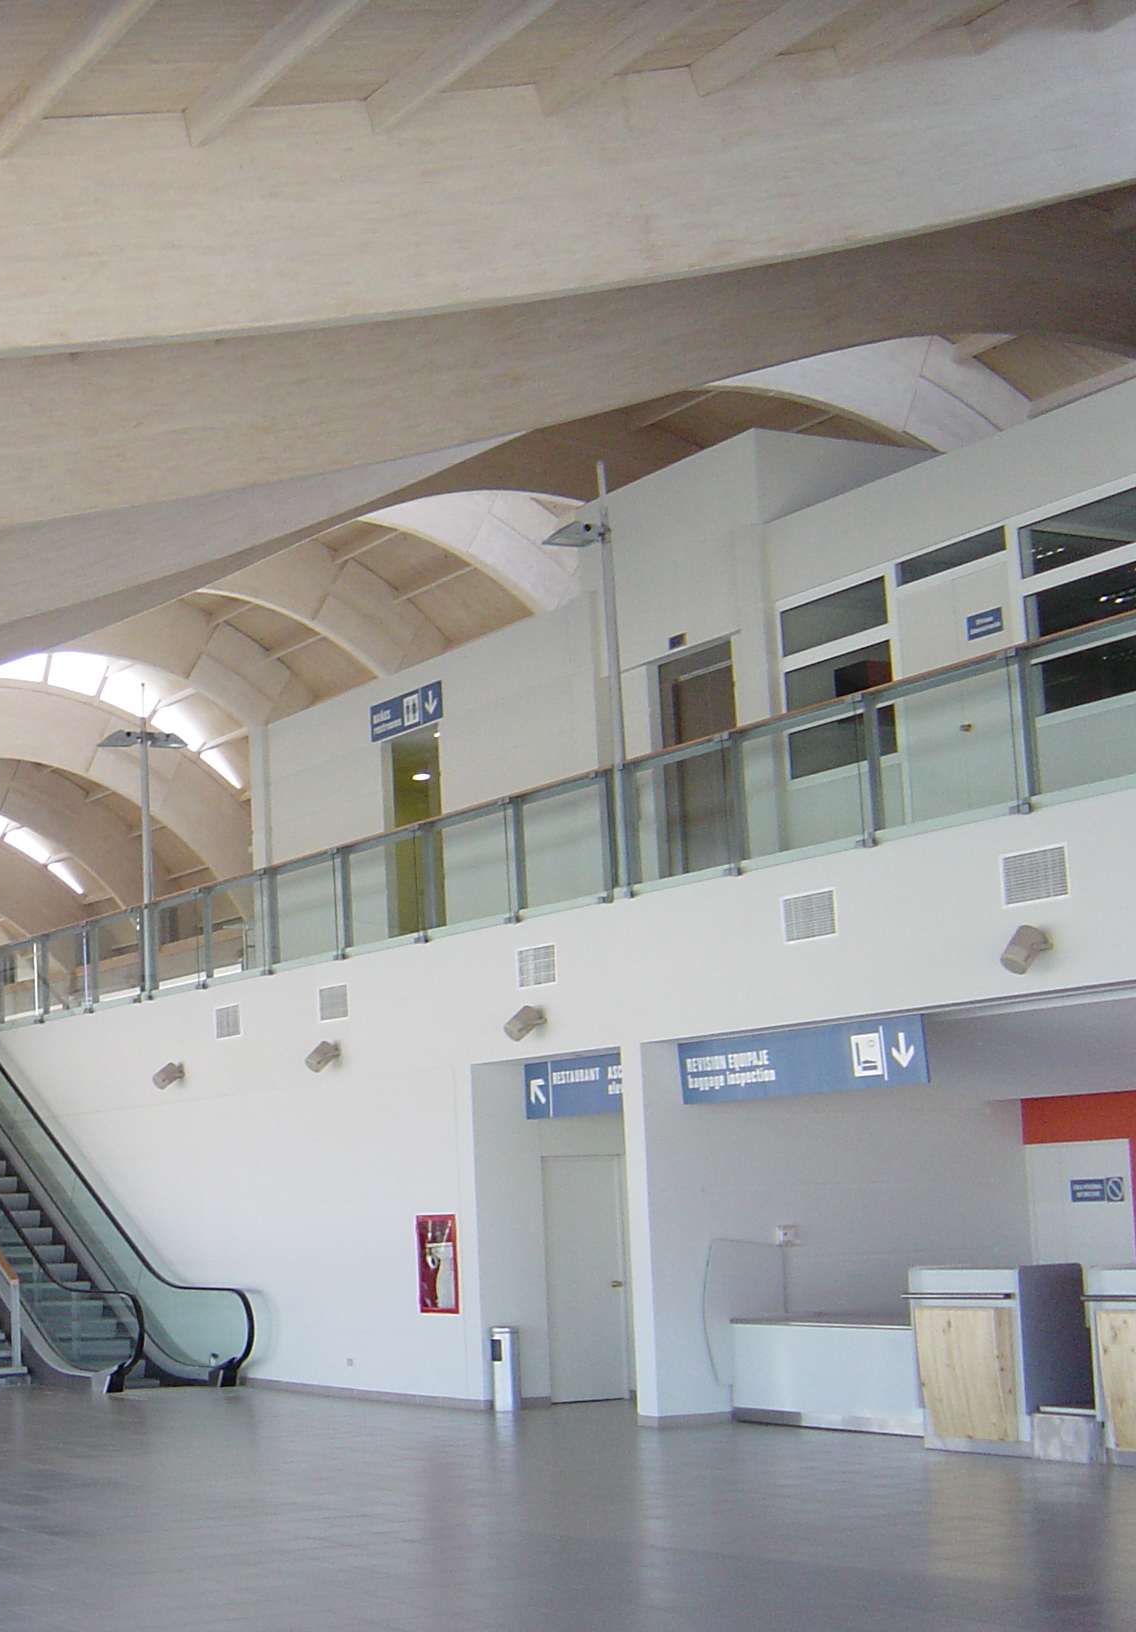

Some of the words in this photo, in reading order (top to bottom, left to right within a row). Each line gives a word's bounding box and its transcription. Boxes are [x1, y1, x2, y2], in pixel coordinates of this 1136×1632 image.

[686, 1055, 727, 1073] REVISION
[728, 1049, 769, 1071] EQUIPAJE
[552, 1067, 599, 1085] RESTAURANT
[687, 1075, 725, 1091] baggage
[726, 1068, 776, 1087] inspection
